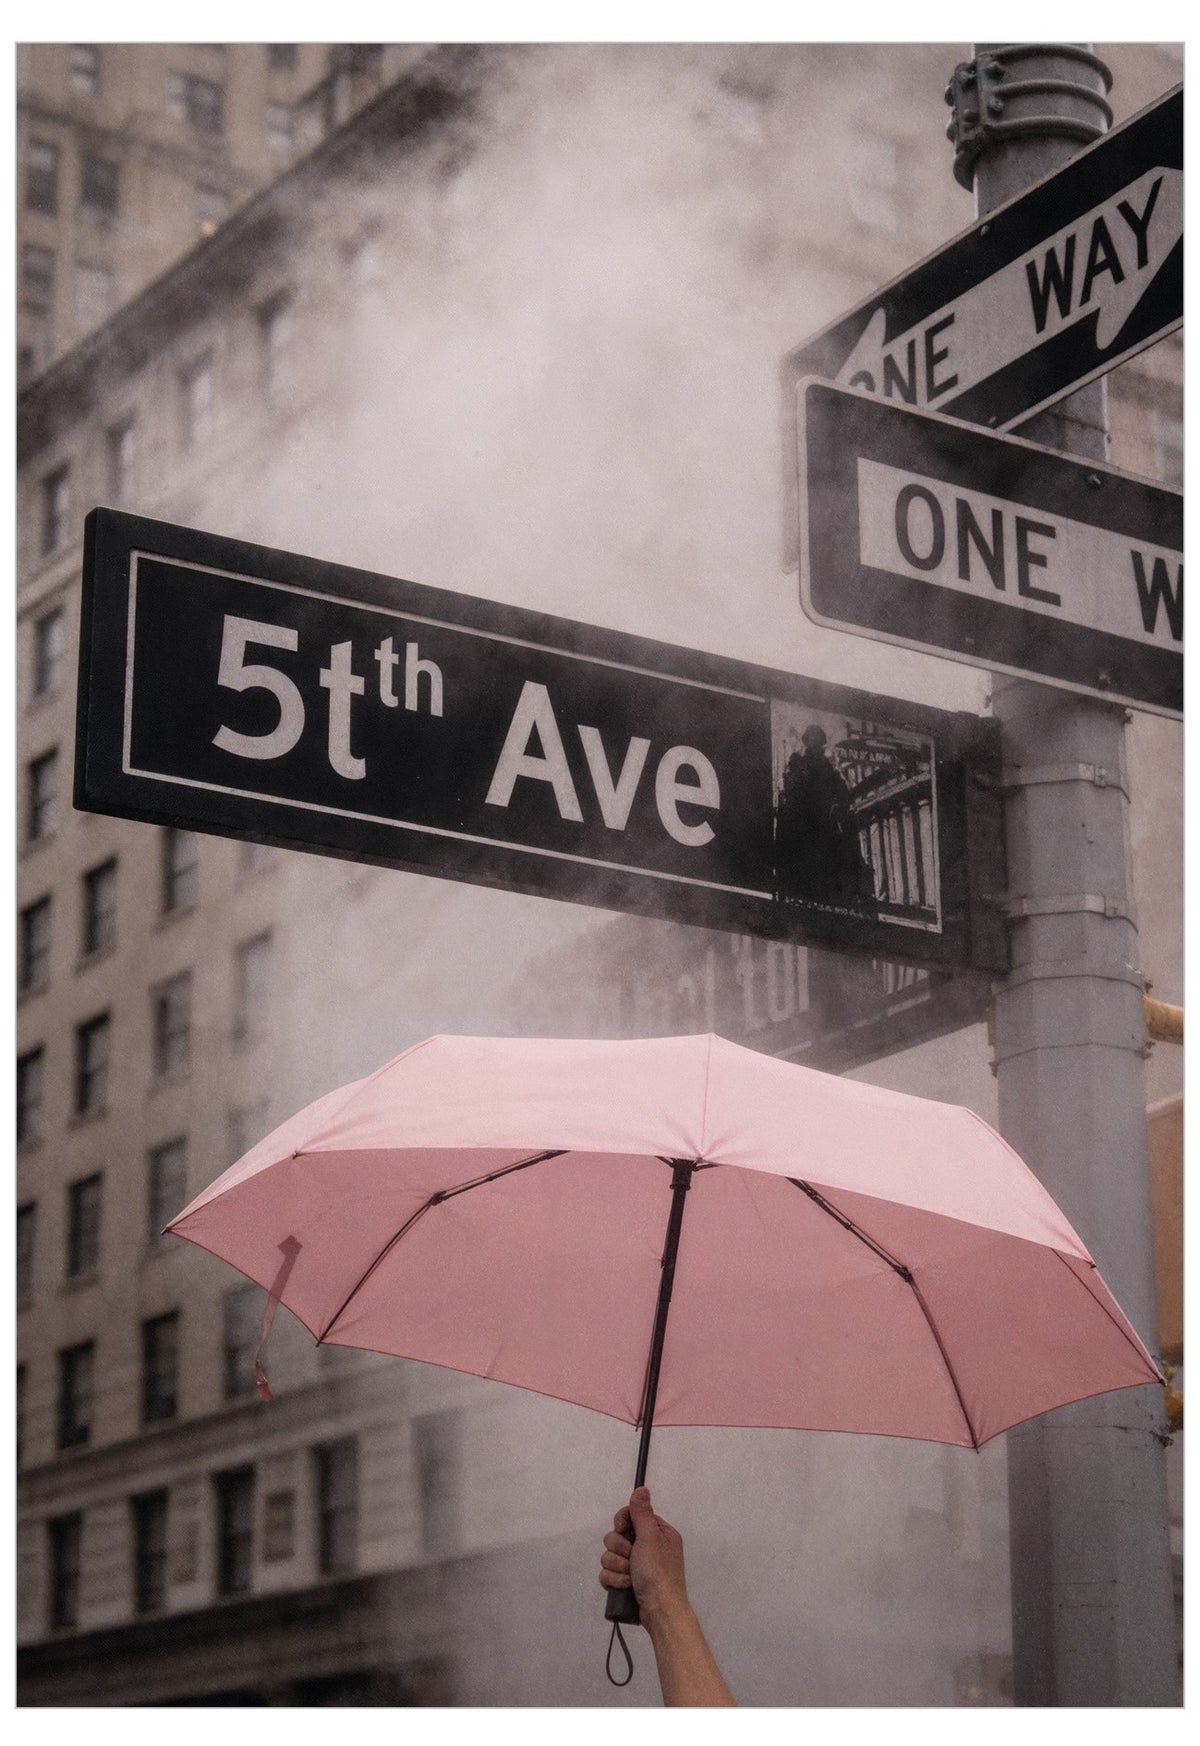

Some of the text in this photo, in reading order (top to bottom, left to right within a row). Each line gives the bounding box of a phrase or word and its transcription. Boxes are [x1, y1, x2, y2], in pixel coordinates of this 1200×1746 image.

[1025, 175, 1164, 335] WAY
[894, 483, 1062, 607] ONE
[484, 680, 721, 848] Ave
